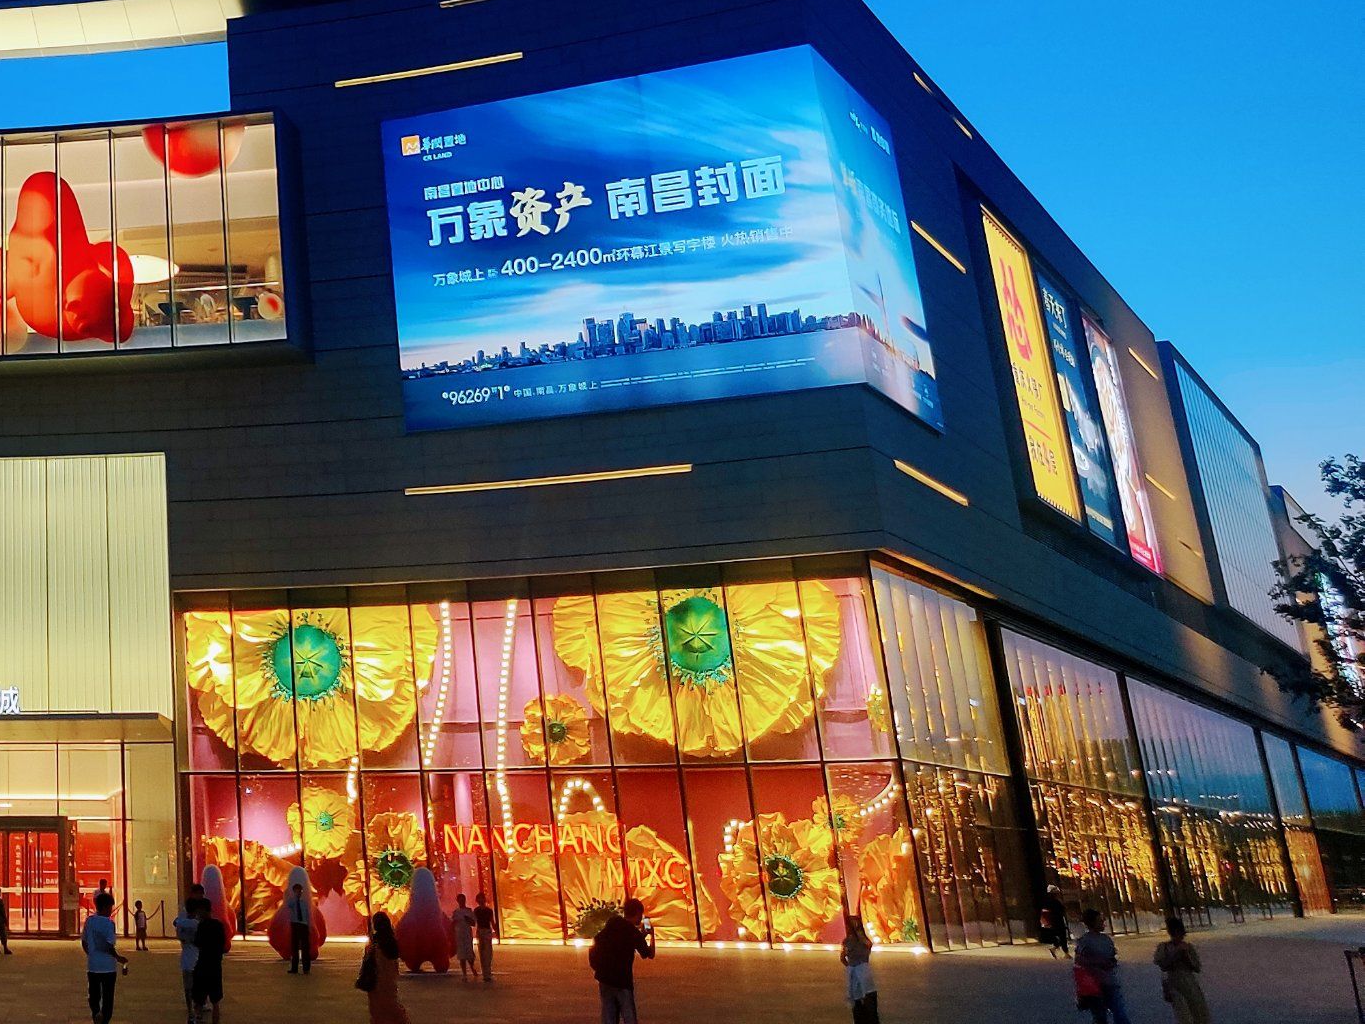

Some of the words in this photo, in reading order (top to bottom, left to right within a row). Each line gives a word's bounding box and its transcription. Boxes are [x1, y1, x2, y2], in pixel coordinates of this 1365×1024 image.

[433, 151, 453, 161] LAND
[423, 176, 505, 201] 南昌置地中心
[426, 181, 593, 247] 万象资产
[605, 155, 786, 220] 南昌封面
[432, 268, 485, 287] 万象城上
[721, 226, 794, 247] 火热销售中
[448, 387, 491, 406] 96269
[443, 822, 625, 855] NANCHANG
[606, 856, 691, 889] MIXC
